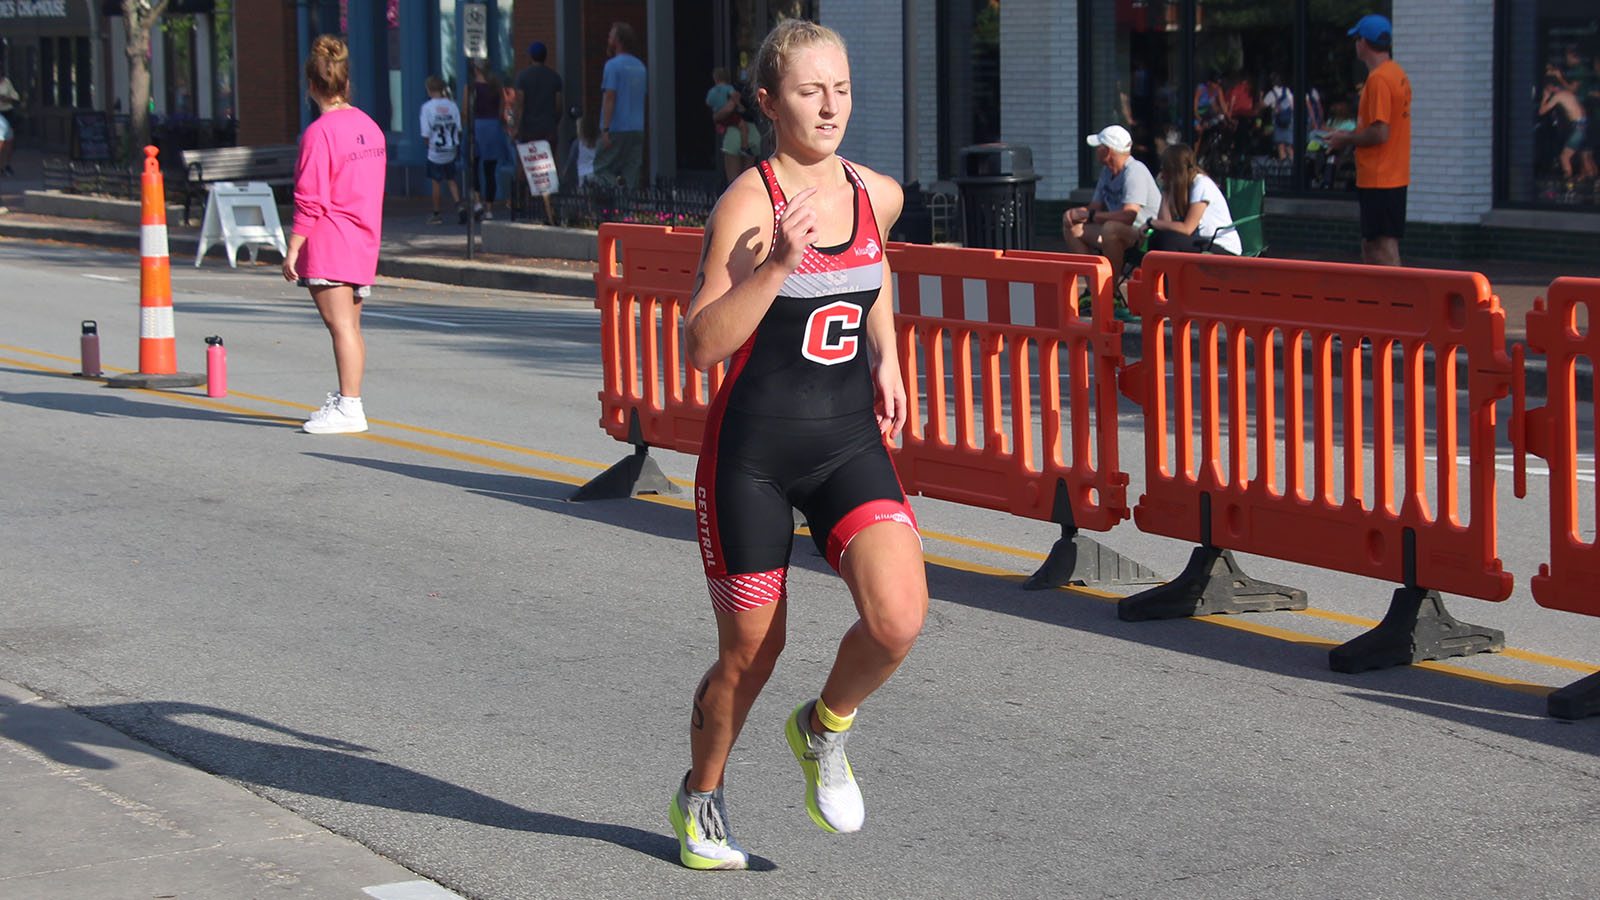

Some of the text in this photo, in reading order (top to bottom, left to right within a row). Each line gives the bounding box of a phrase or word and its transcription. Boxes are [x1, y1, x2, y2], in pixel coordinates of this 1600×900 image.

[432, 122, 459, 147] 37
[801, 300, 863, 366] C
[698, 486, 716, 567] CENTRAL
